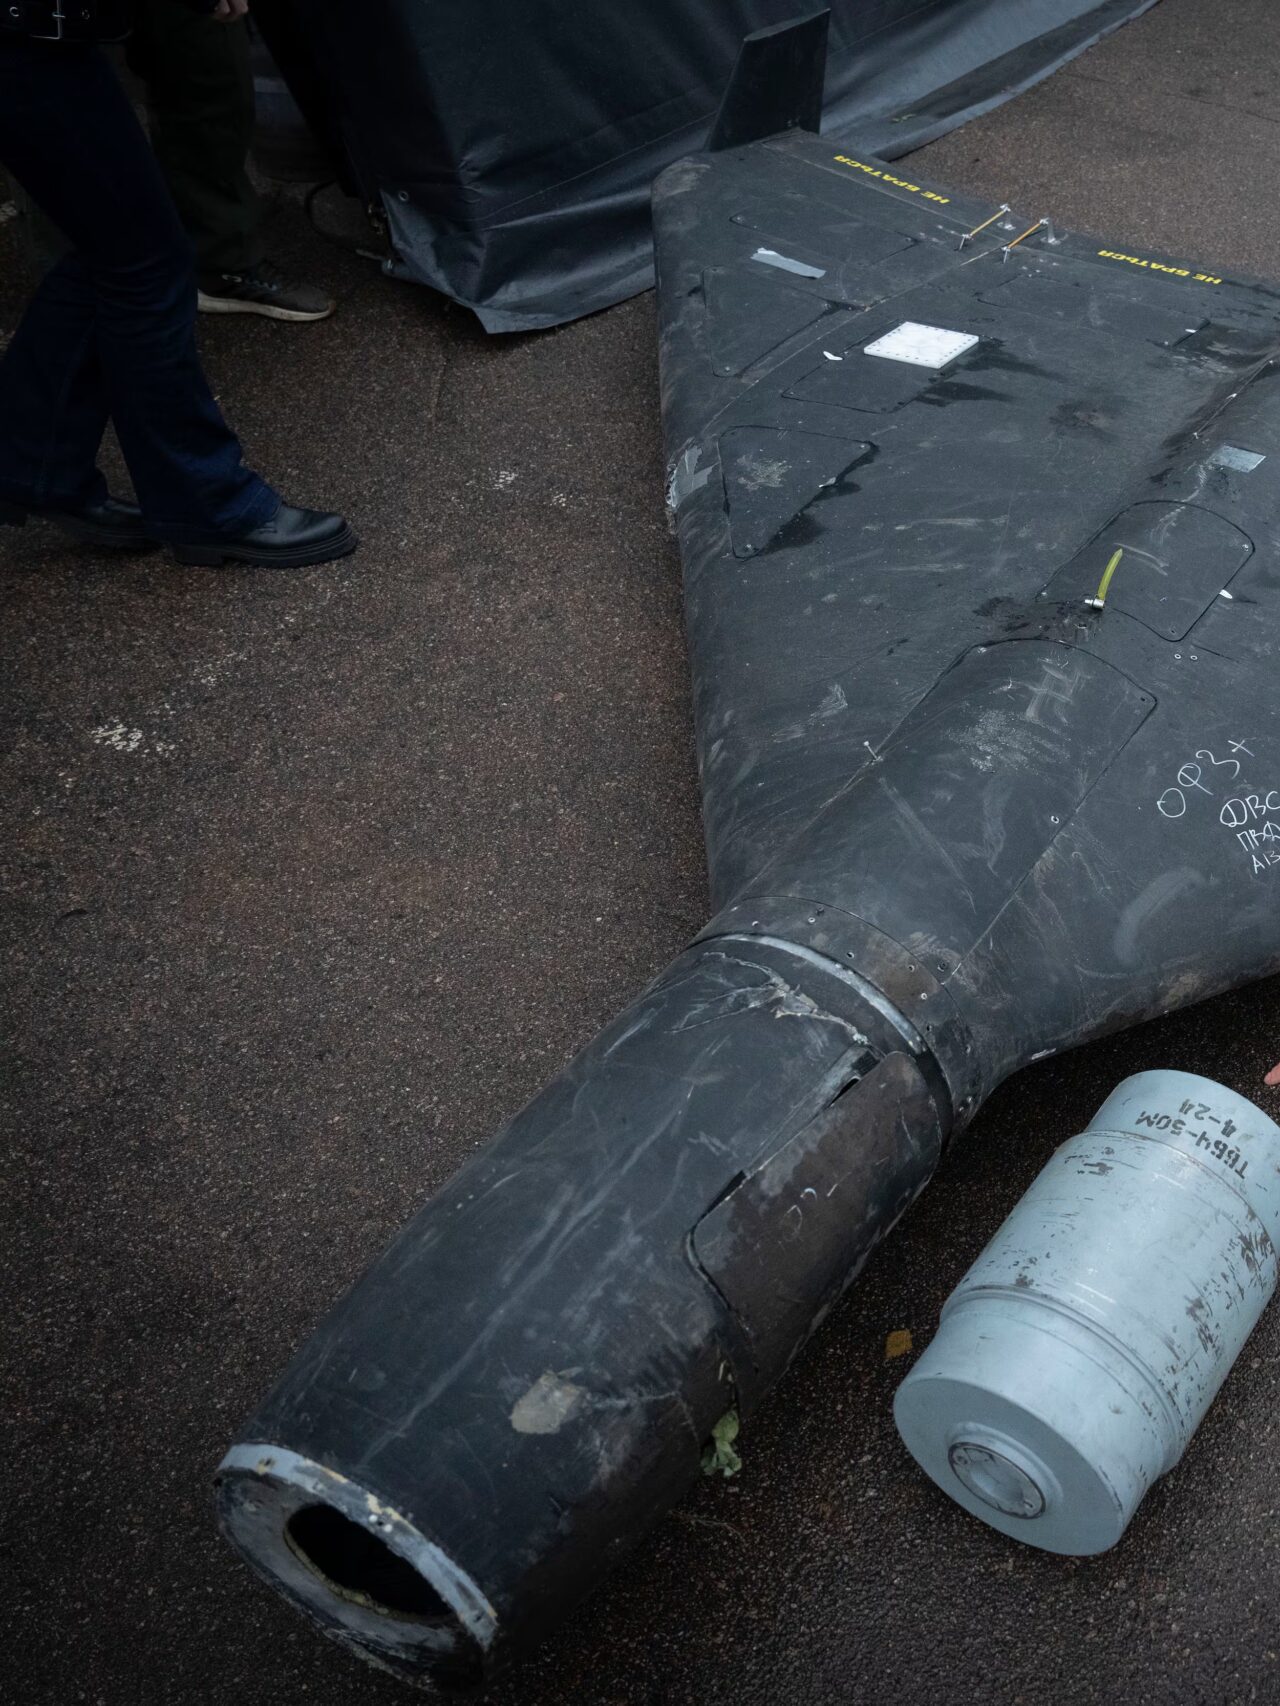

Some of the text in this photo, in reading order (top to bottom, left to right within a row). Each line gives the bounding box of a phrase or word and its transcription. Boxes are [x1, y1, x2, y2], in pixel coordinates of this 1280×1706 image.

[833, 154, 951, 204] НЕ БРАТЬСЯ
[1097, 249, 1223, 285] НЕ БРАТЬСЯ
